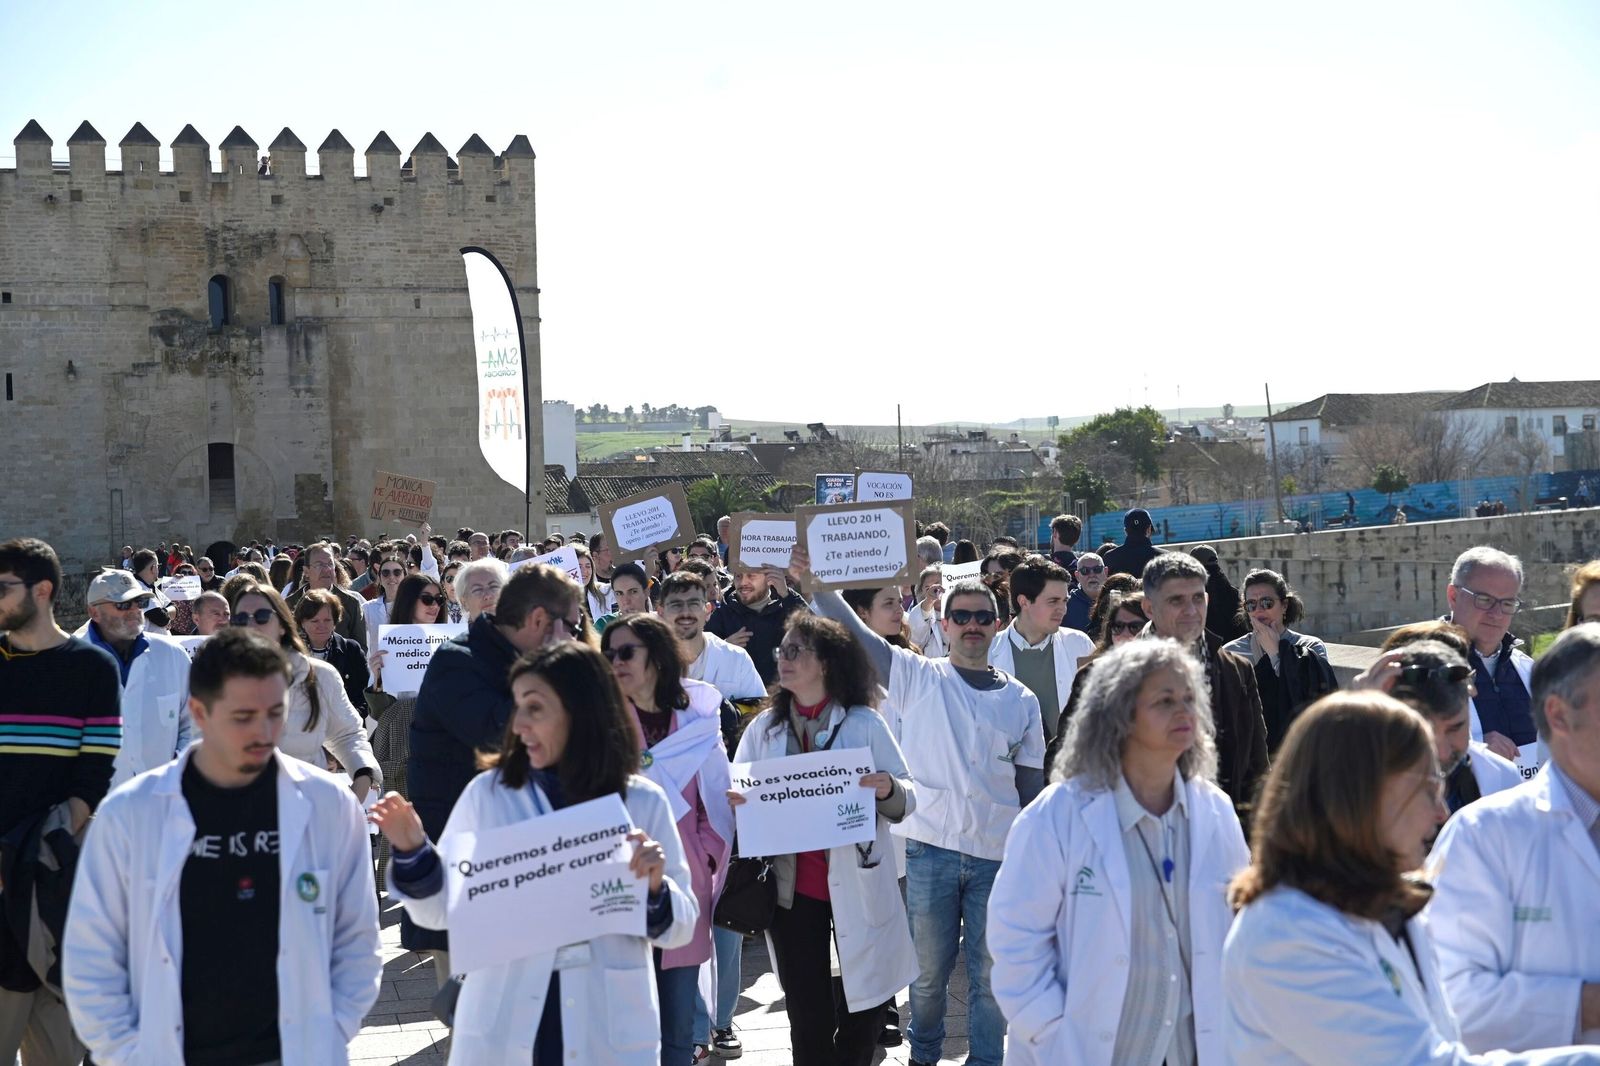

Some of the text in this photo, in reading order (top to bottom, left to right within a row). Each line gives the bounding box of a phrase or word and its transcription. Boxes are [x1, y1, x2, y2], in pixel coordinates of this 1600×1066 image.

[866, 481, 903, 490] VOCACIÓN
[370, 500, 386, 519] NO
[625, 505, 660, 521] LLEVO 20H
[640, 521, 660, 532] atiendo
[827, 513, 882, 526] LLEVO 20 H
[625, 537, 641, 545] opero
[644, 525, 672, 539] anestesio?
[741, 534, 761, 542] HORA
[821, 529, 891, 543] TRABAJANDO,
[825, 550, 842, 561] ¿Te
[844, 547, 882, 559] atiendo
[814, 567, 843, 578] opero
[852, 561, 904, 575] anestesio?
[395, 648, 431, 658] médico
[765, 776, 781, 785] es
[783, 765, 852, 782] vocación,
[855, 765, 872, 775] es
[838, 802, 865, 816] SMA
[229, 831, 248, 856] IS
[468, 877, 510, 900] para
[514, 861, 564, 888] poder
[590, 877, 633, 899] SMA
